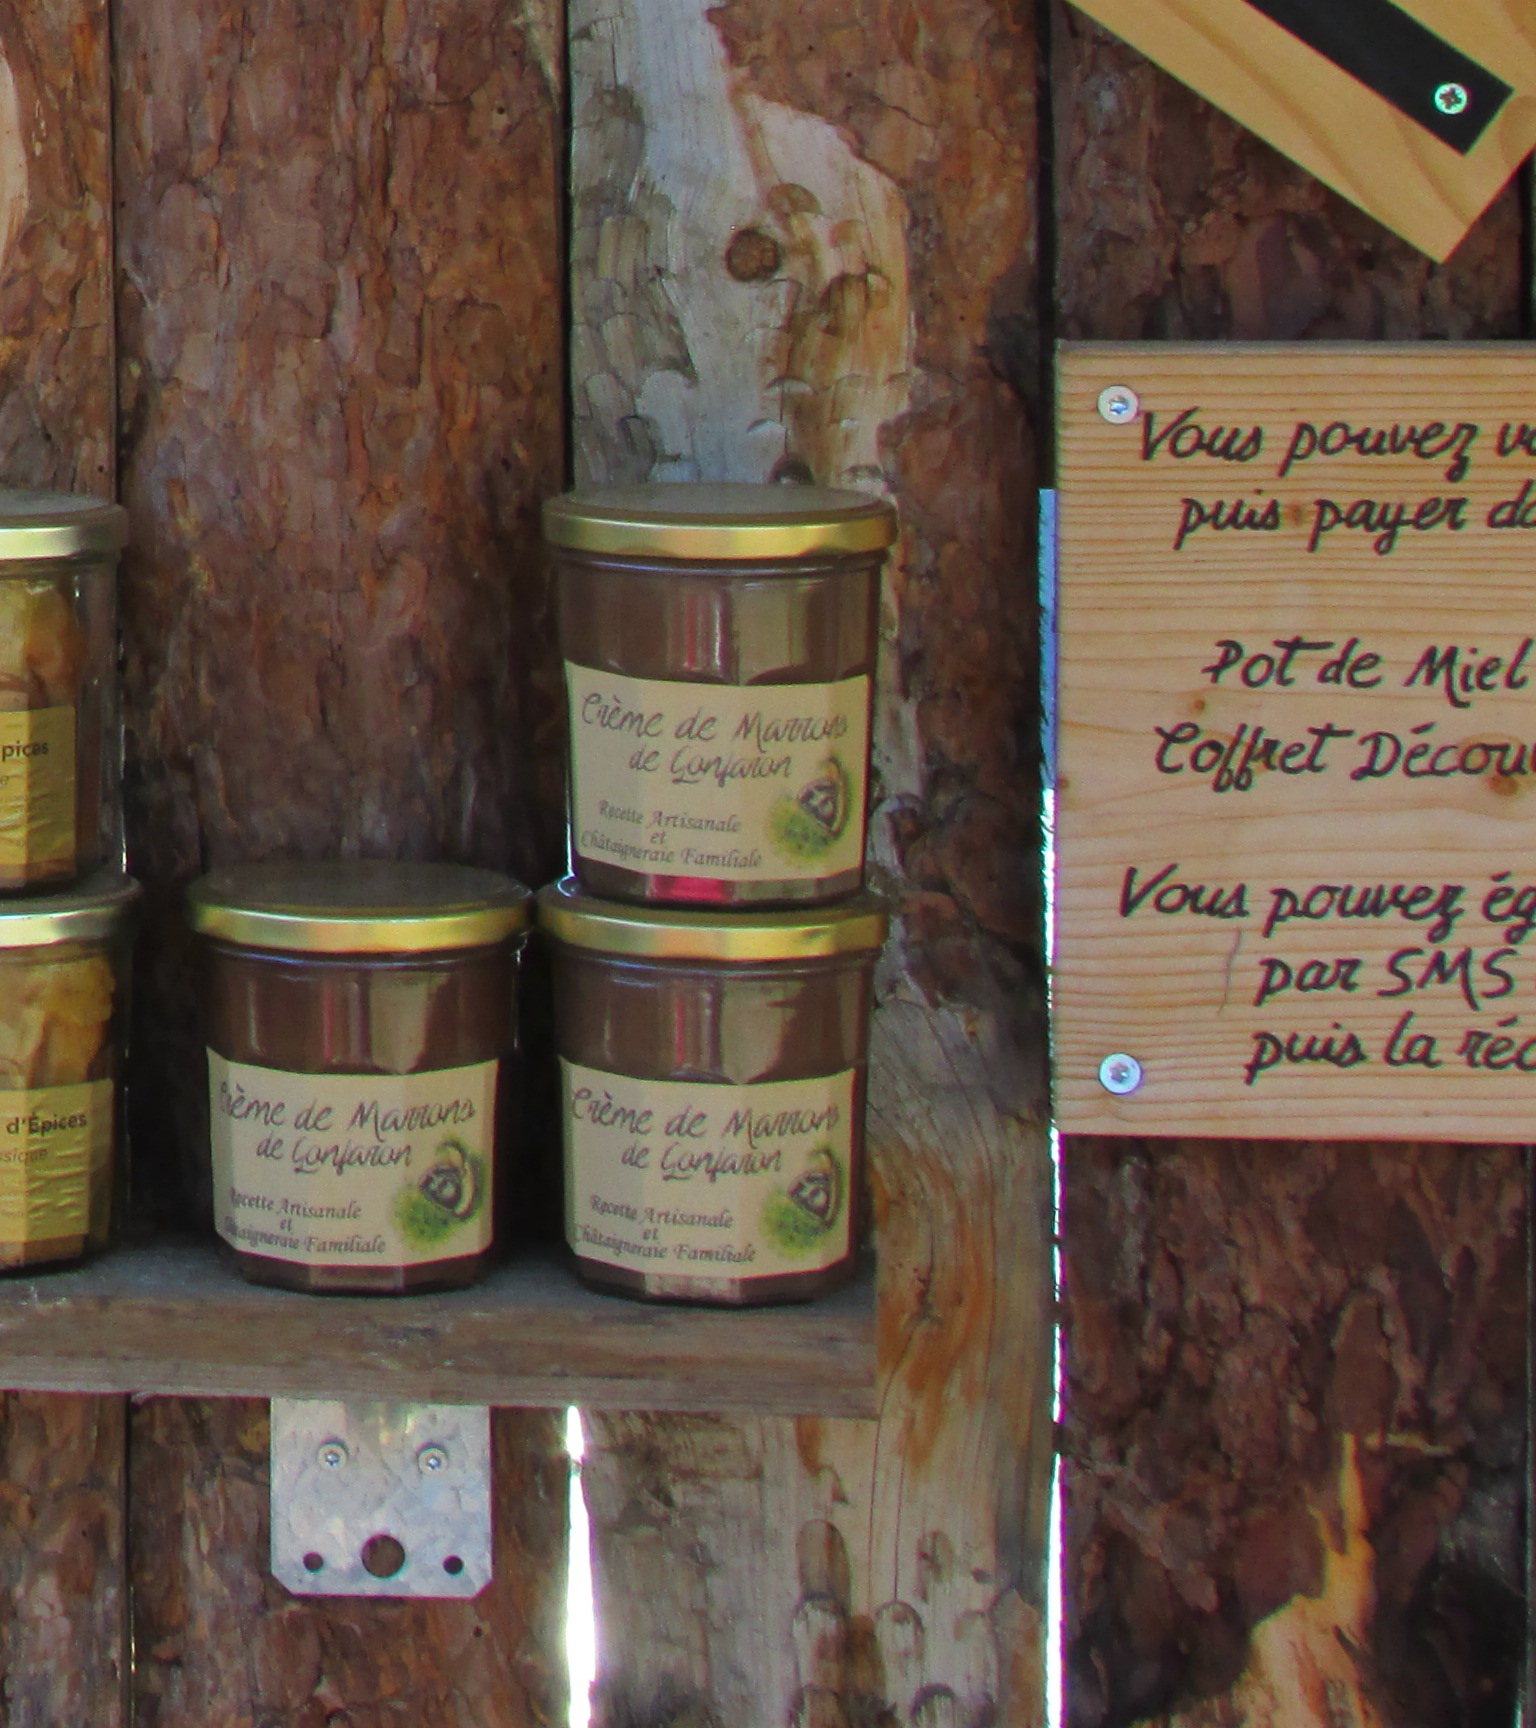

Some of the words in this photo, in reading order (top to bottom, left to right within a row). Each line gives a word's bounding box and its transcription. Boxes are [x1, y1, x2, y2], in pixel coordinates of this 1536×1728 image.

[1141, 405, 1263, 463] Vous
[1277, 421, 1480, 483] pouvez
[1172, 489, 1281, 552] puis
[1306, 495, 1470, 556] payer
[1201, 635, 1336, 688] Pot
[1316, 636, 1383, 689] de
[1403, 637, 1533, 709] Miel
[582, 692, 664, 739] Crème
[674, 706, 719, 742] de
[628, 743, 659, 773] de
[1154, 721, 1356, 794] Coffret
[1119, 863, 1249, 918] Vous
[1261, 882, 1467, 944] pouvez
[1253, 957, 1363, 1007] par
[1376, 947, 1519, 1012] SMS
[1244, 1023, 1368, 1086] puis
[1383, 1010, 1443, 1069] la
[6, 1111, 87, 1137] d'Épices
[295, 1098, 333, 1132] de
[351, 1098, 476, 1143] Marrons
[572, 1088, 654, 1137] Crème
[664, 1105, 708, 1139] de
